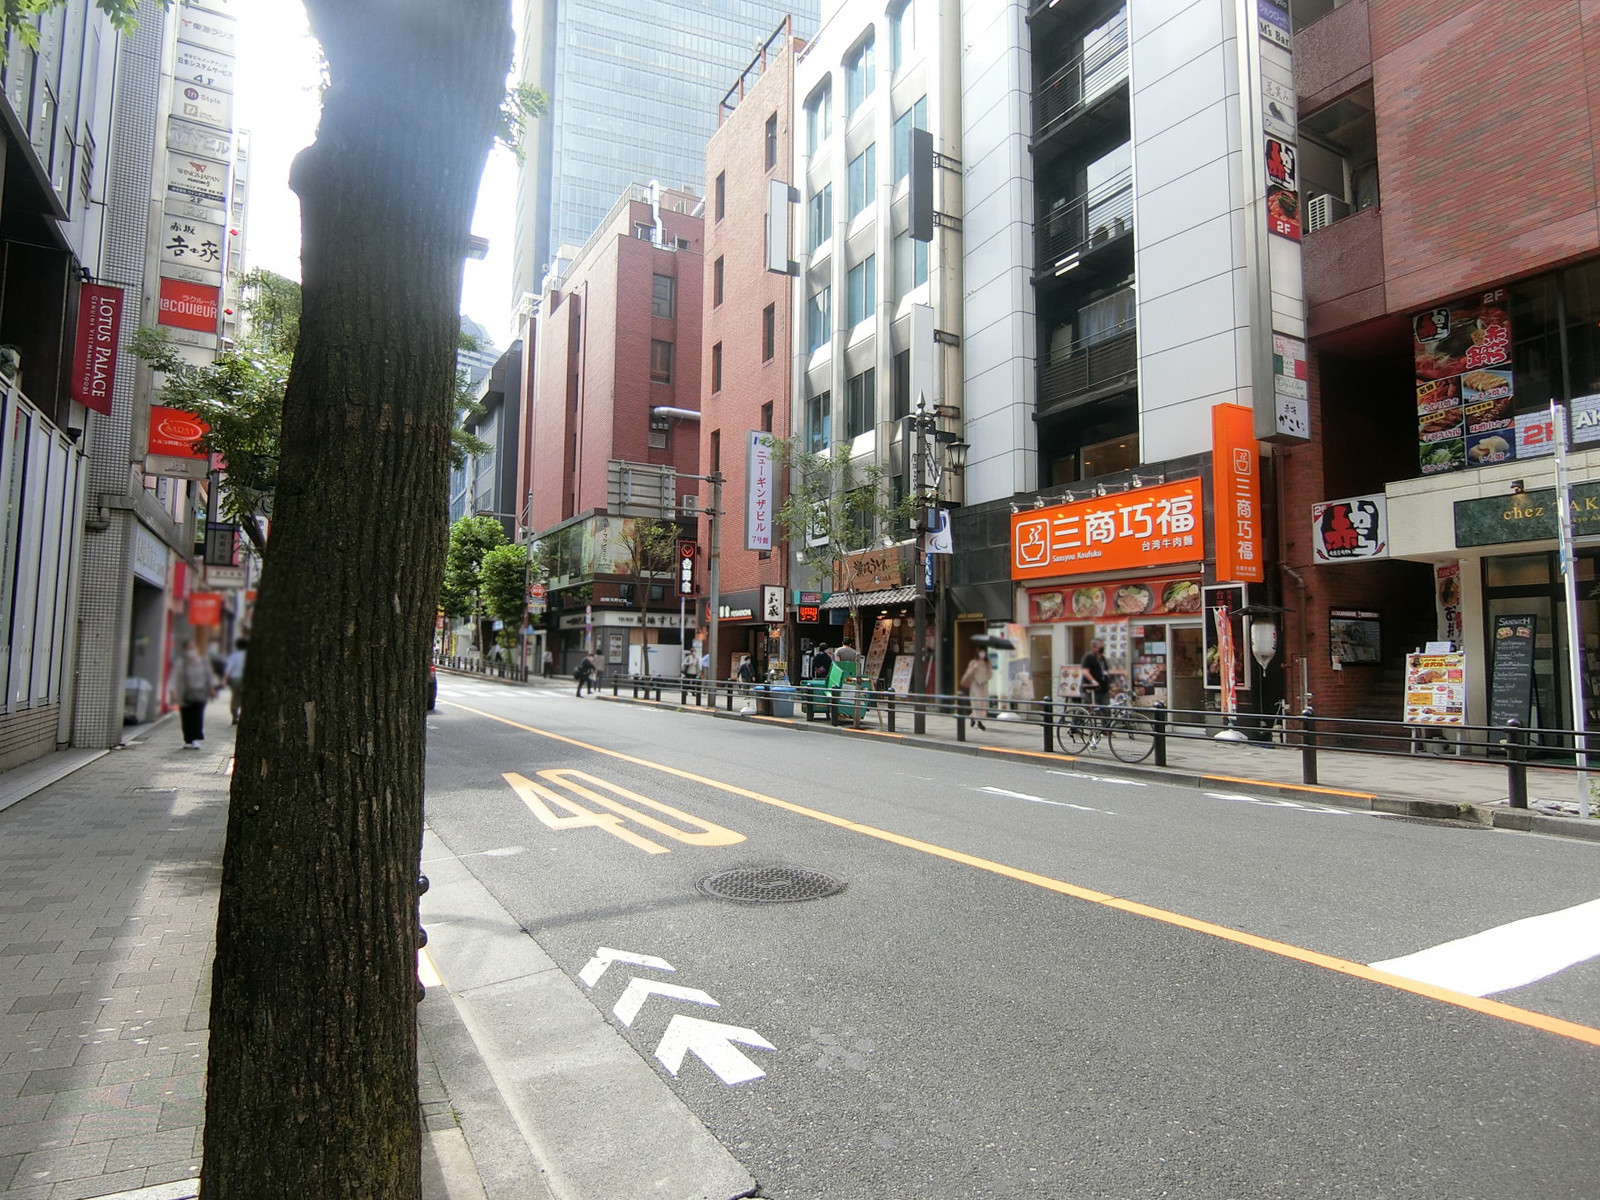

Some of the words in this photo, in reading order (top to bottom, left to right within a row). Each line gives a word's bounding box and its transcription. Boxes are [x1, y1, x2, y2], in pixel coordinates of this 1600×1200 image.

[1275, 30, 1289, 46] Bar
[201, 94, 222, 105] Style
[1276, 221, 1291, 234] 2F
[1484, 290, 1503, 303] 2F
[97, 297, 116, 342] LOTUS
[92, 346, 112, 397] PALACE
[756, 450, 767, 533] ニューギンザビル
[1503, 506, 1544, 520] chez
[1052, 494, 1195, 550] 三商巧福
[1236, 478, 1253, 560] 三商巧福
[501, 768, 748, 855] 40
